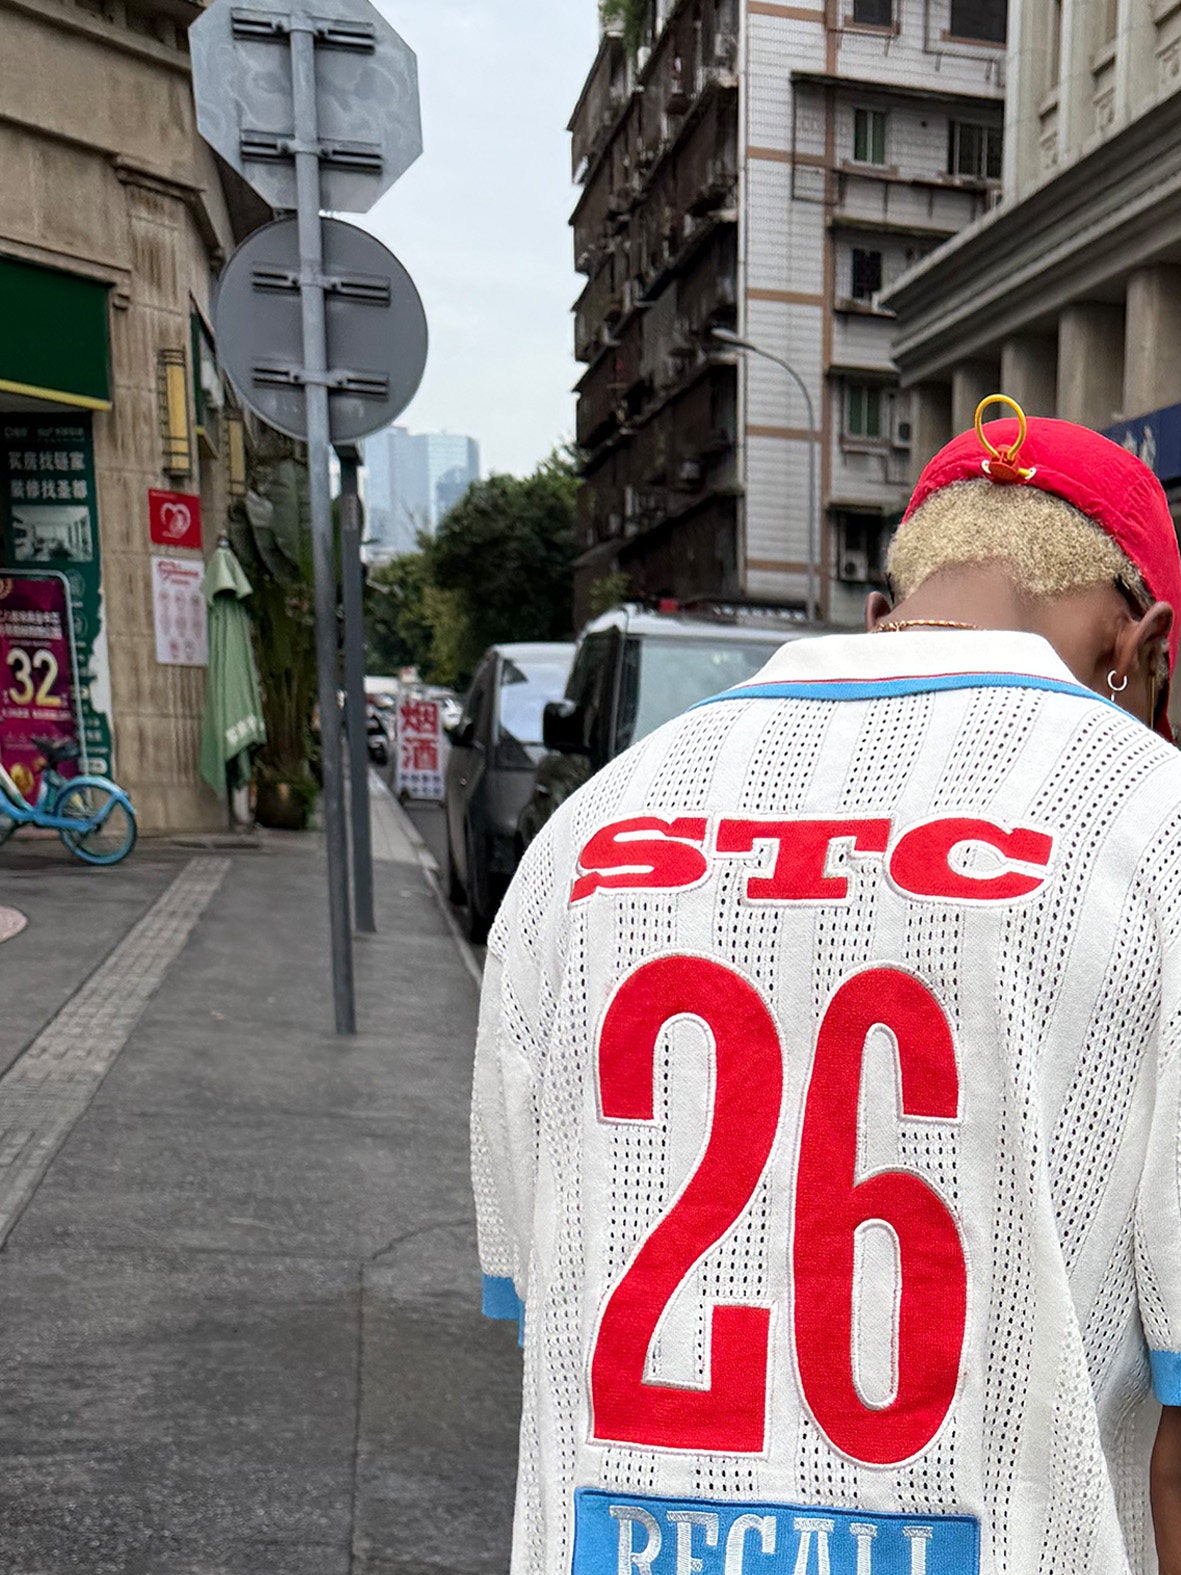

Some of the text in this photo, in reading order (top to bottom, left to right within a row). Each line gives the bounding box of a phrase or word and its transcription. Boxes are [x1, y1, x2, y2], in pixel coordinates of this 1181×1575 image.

[6, 647, 62, 707] 32
[400, 700, 438, 770] 烟酒
[568, 814, 1054, 904] STC
[589, 953, 969, 1466] 26
